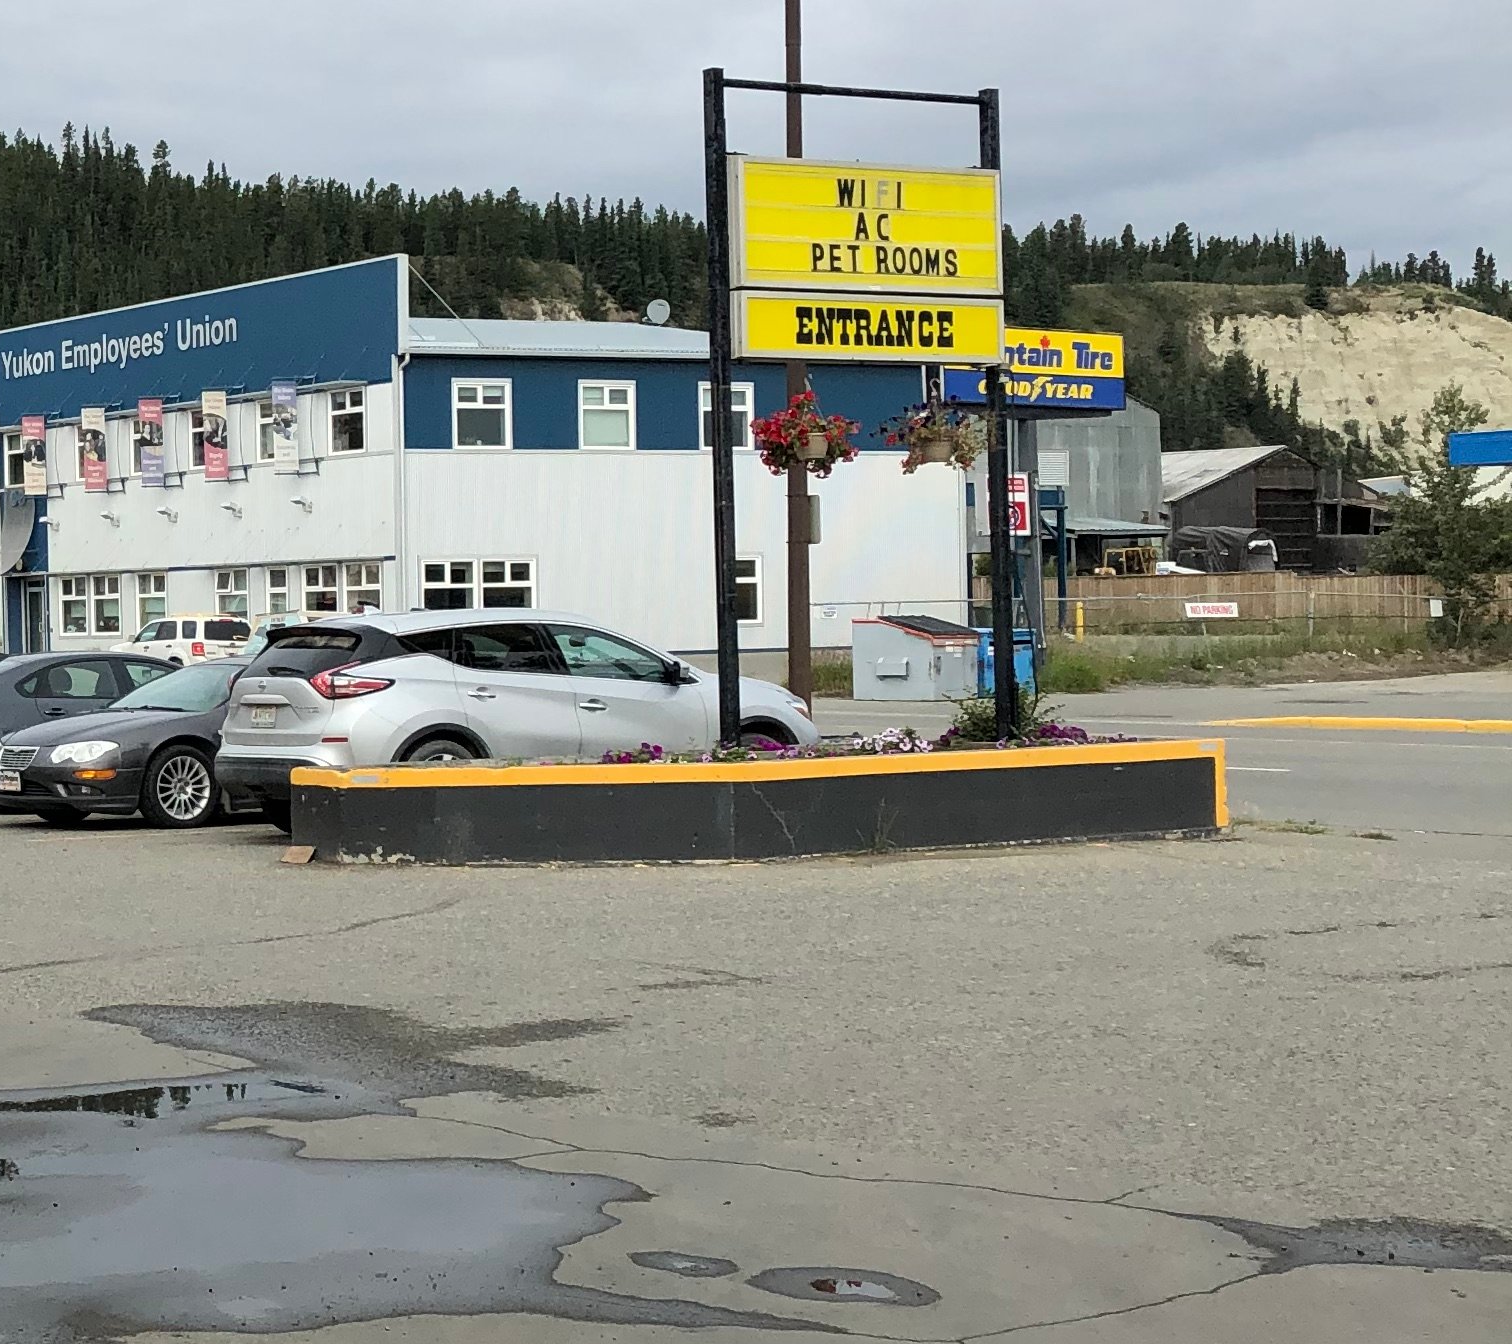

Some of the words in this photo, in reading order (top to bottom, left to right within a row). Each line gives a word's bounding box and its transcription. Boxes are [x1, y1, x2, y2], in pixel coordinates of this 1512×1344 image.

[855, 212, 890, 241] AC
[812, 243, 860, 273] PET
[876, 246, 958, 277] ROOMS
[796, 306, 954, 348] ENTRANCE
[1, 348, 55, 380] Yukon
[177, 314, 237, 351] Union
[1005, 340, 1062, 368] ntain
[1072, 341, 1113, 370] Tire
[978, 377, 1094, 402] GODYEAR
[1190, 605, 1201, 615] NO
[1202, 604, 1234, 615] PARKING
